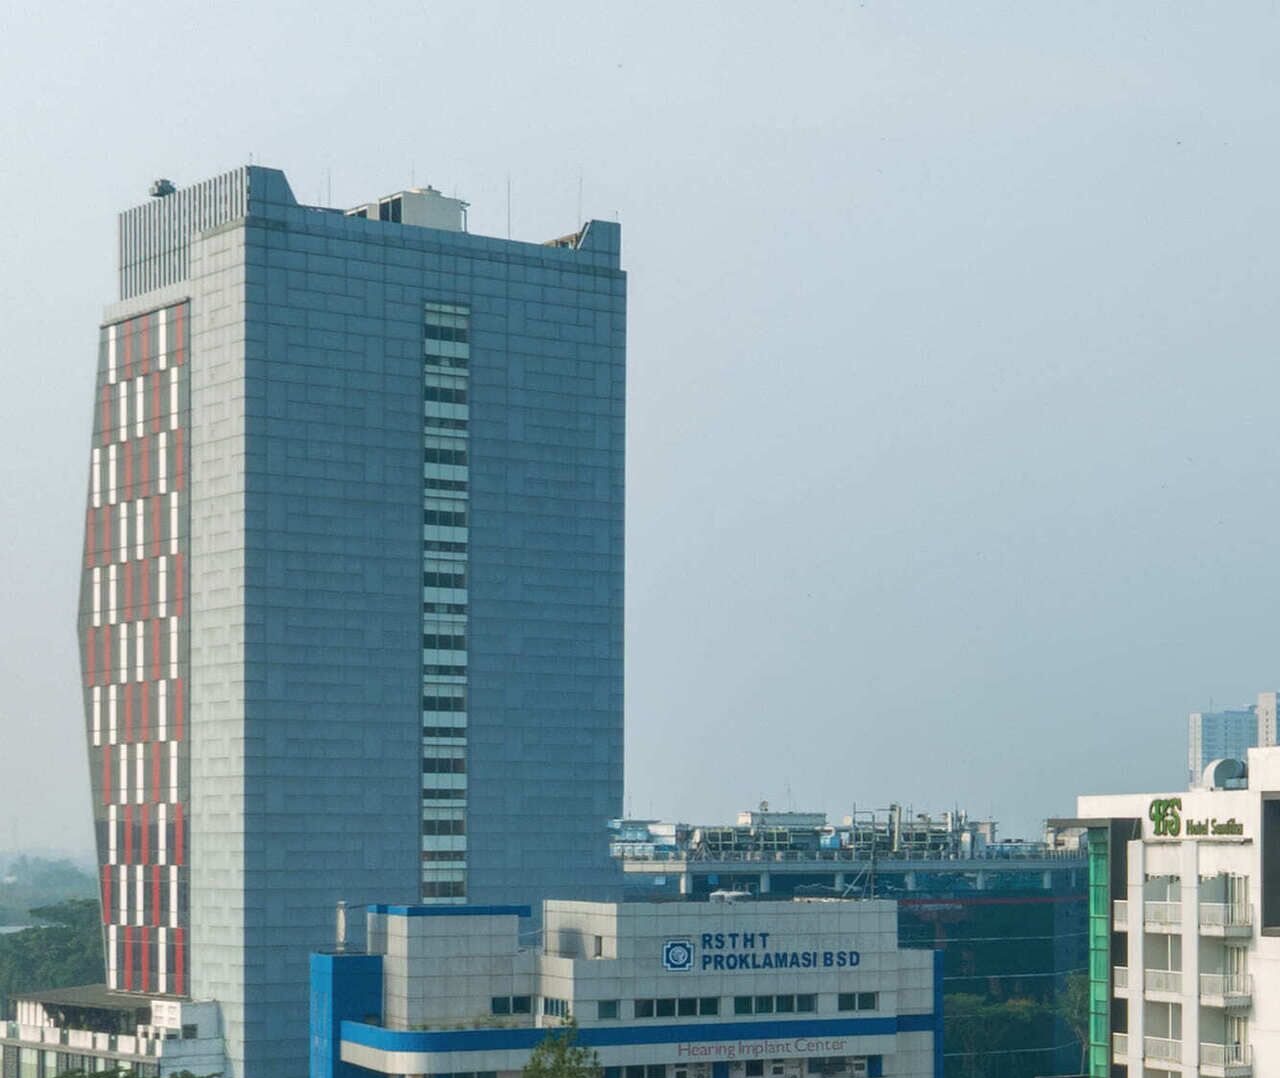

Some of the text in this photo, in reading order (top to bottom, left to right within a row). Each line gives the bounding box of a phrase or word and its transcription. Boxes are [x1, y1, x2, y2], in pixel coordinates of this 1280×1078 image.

[702, 951, 861, 970] PROKLAMASI BSD
[677, 1037, 847, 1058] Hearing Implant Center
